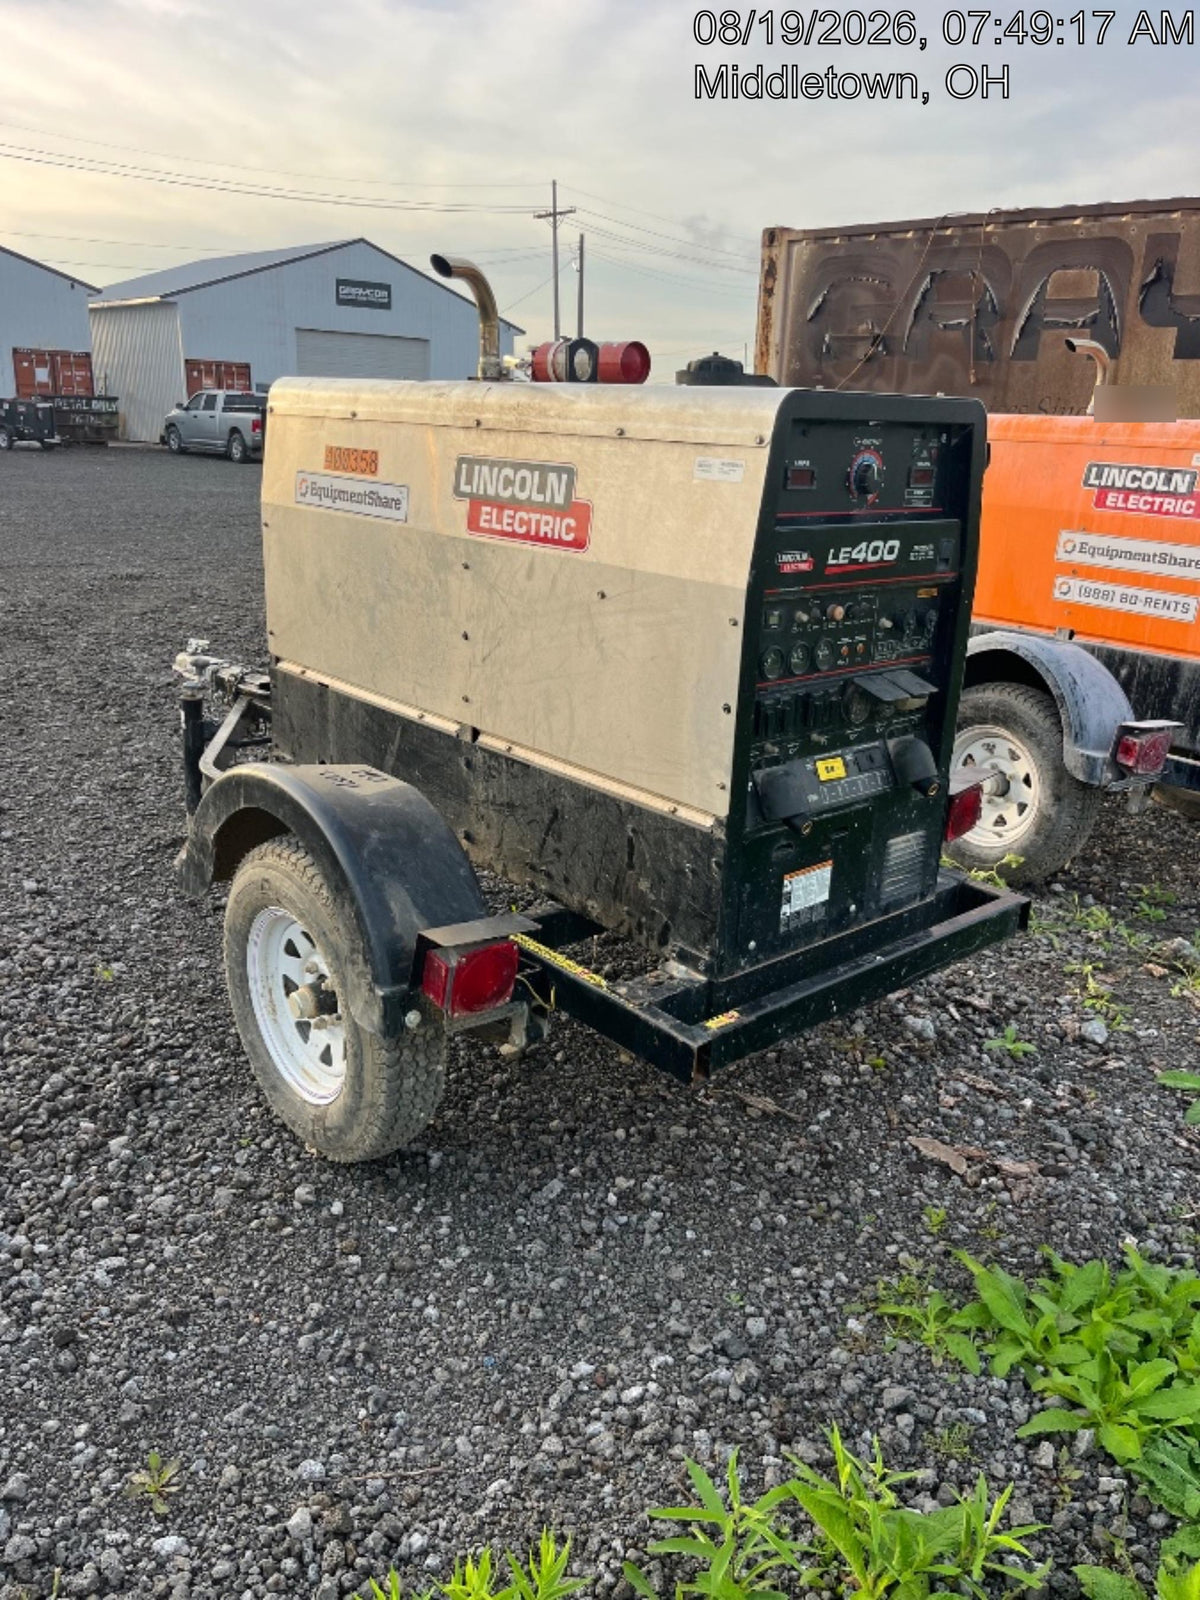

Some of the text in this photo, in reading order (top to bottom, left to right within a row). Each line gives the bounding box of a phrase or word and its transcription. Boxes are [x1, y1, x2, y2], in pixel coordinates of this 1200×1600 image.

[460, 463, 568, 505] LINCOLN
[1088, 466, 1190, 493] LINCOLN
[310, 481, 402, 511] EquipmentShare
[1105, 493, 1196, 514] ELECTRIC
[479, 506, 577, 541] ELECTRIC
[827, 540, 900, 565] LE400
[1078, 584, 1116, 601] (888)
